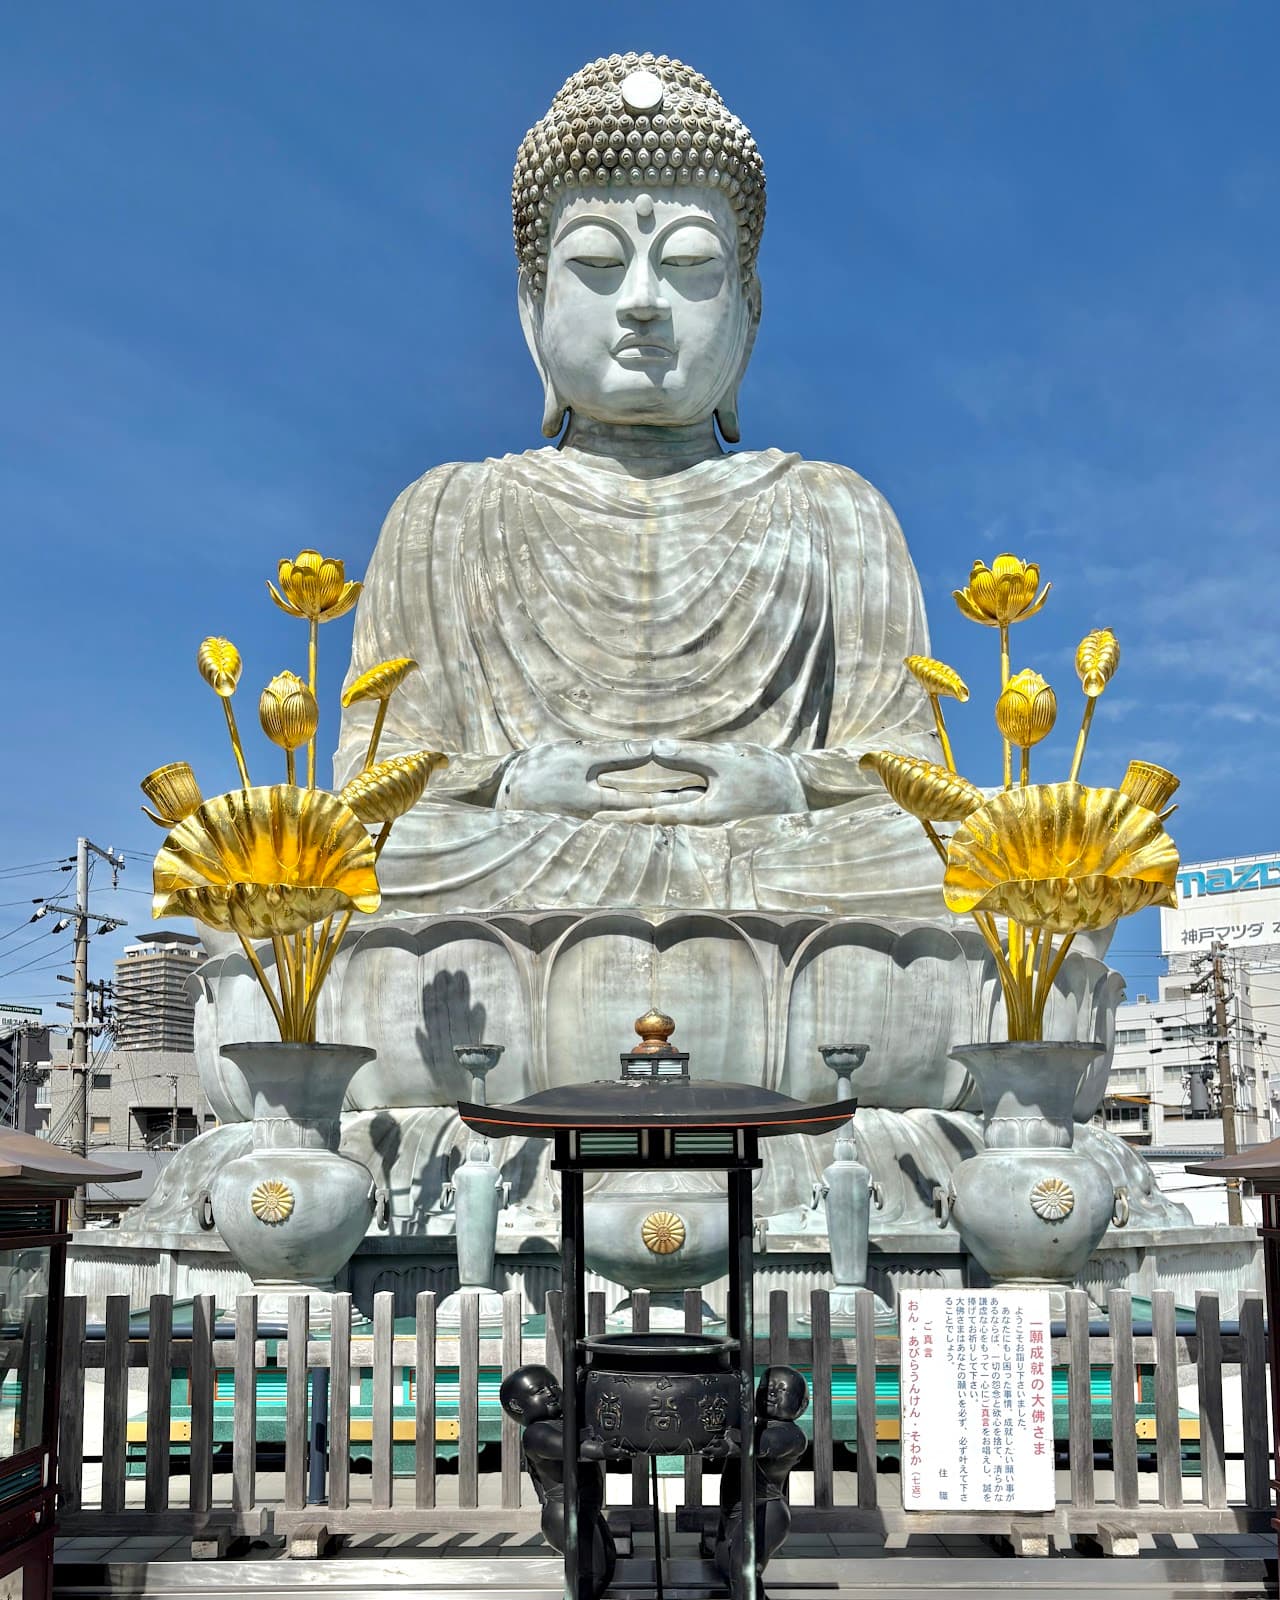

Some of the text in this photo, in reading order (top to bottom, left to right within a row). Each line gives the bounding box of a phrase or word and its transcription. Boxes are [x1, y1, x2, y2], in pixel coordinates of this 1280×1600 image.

[1181, 922, 1264, 945] 神戸マツダ
[923, 1320, 934, 1358] ご真言
[1029, 1321, 1046, 1455] 一願成就の大佛さま
